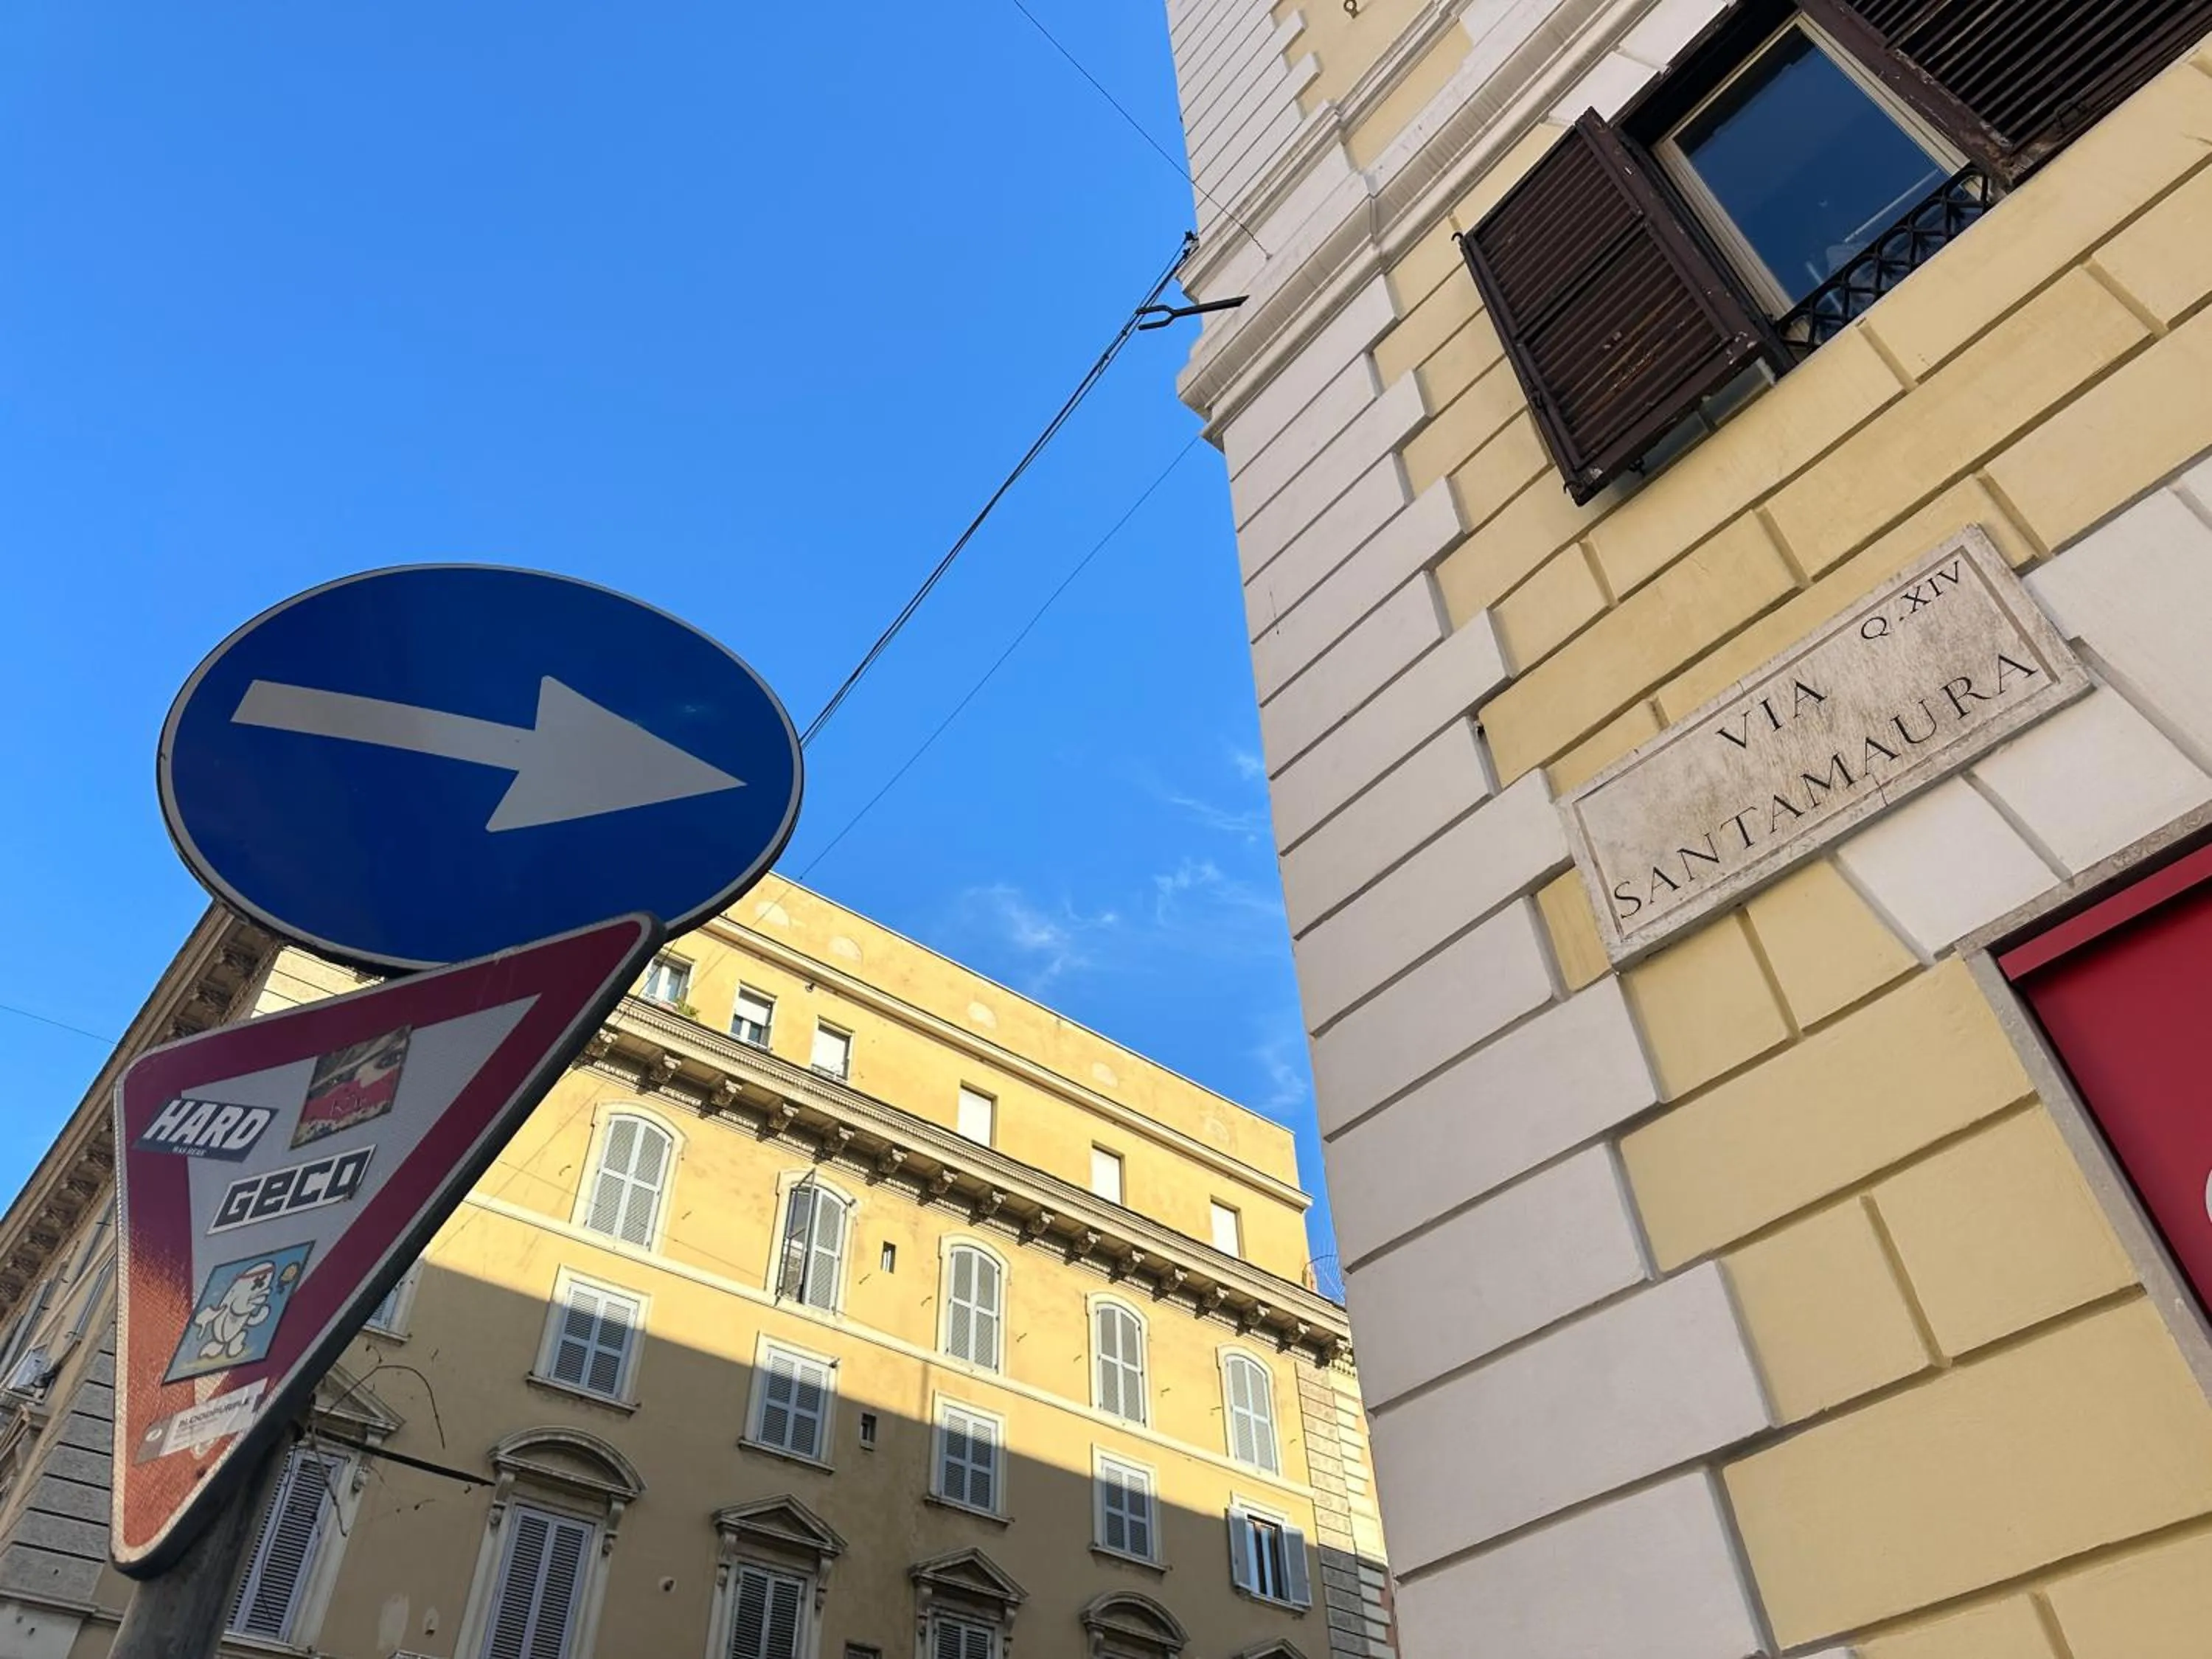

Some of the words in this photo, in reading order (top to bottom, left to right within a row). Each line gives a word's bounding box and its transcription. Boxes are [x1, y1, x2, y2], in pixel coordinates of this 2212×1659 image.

[1716, 678, 1827, 751] VIA
[1613, 653, 2038, 919] SANTAMAURA
[142, 1099, 271, 1150] HARD
